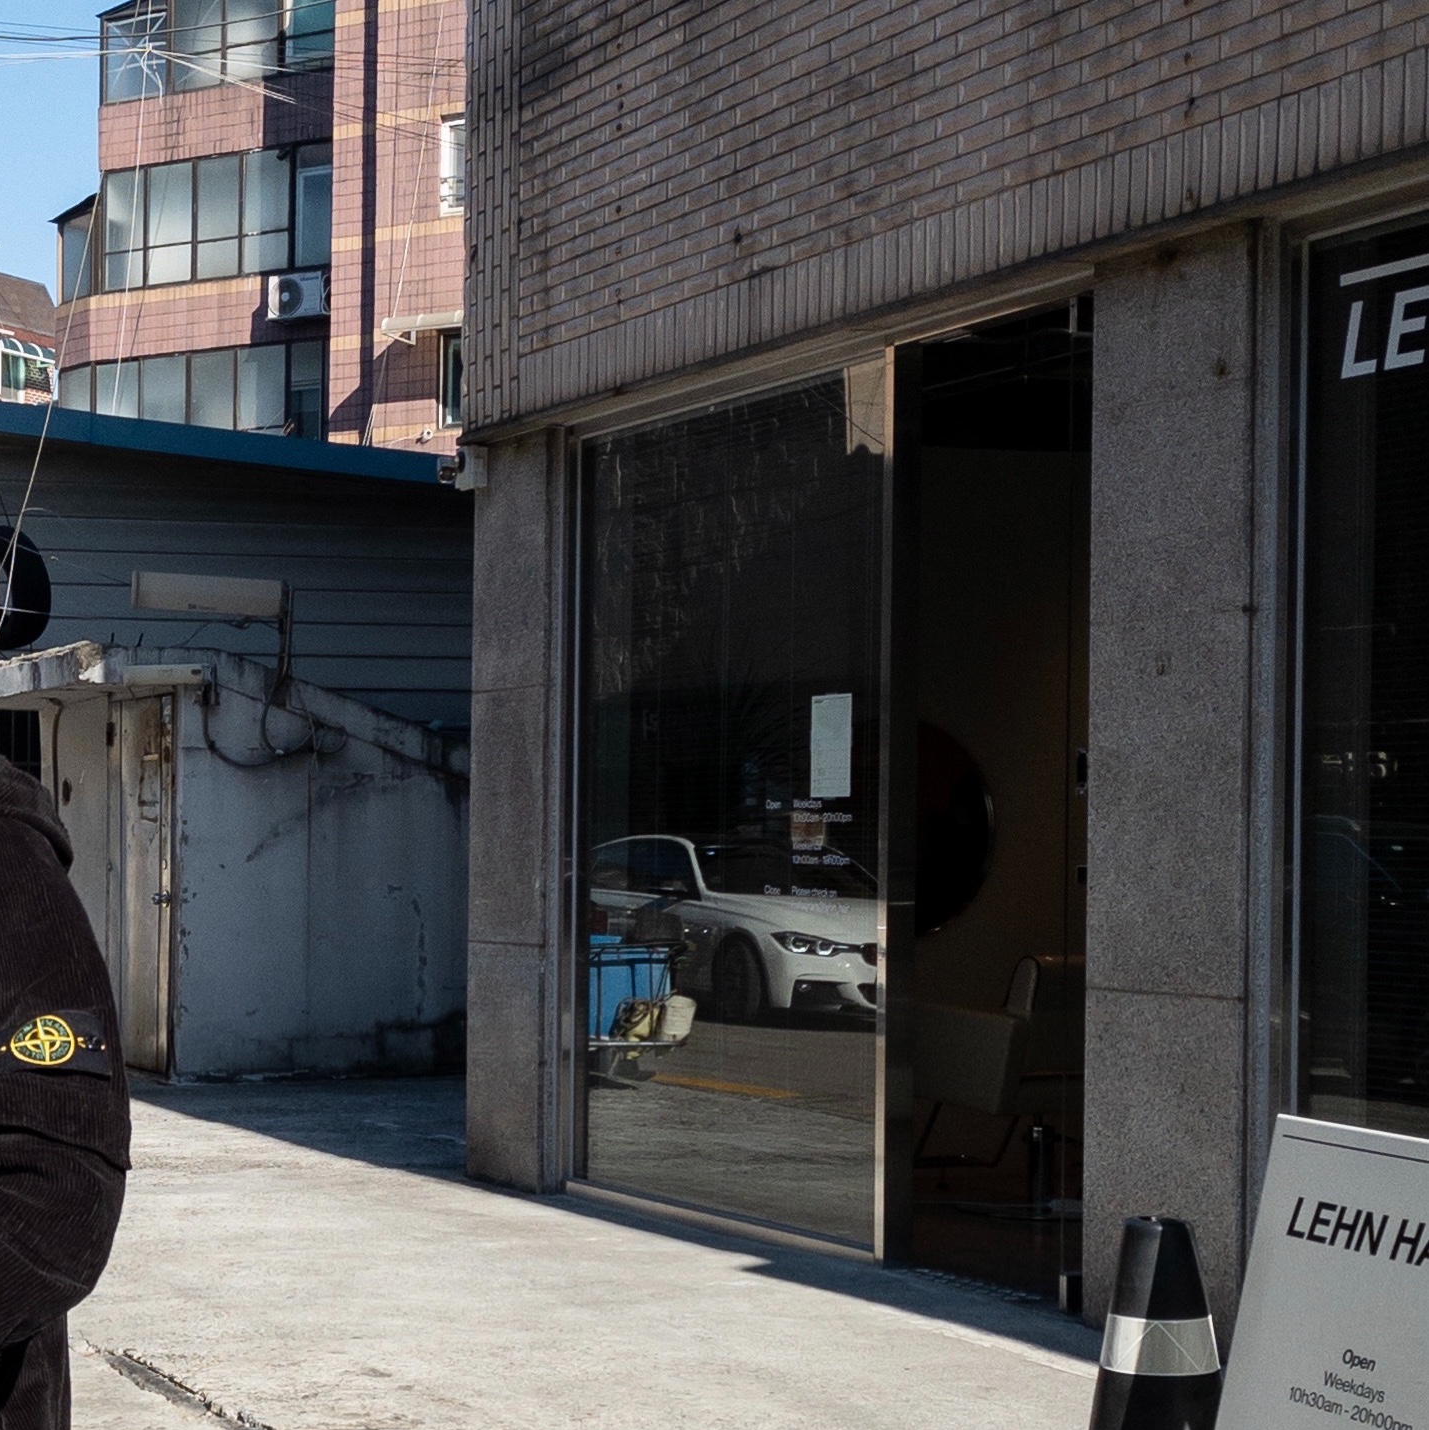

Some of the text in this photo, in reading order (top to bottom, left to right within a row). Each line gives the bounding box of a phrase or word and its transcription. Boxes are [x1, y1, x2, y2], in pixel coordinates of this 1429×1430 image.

[1340, 285, 1429, 379] LE
[765, 799, 781, 809] Open
[764, 884, 781, 895] Close
[1286, 1196, 1389, 1256] LEHN
[1342, 1349, 1376, 1371] Open
[1289, 1386, 1342, 1415] 10h30am
[1324, 1370, 1385, 1403] Weekdays
